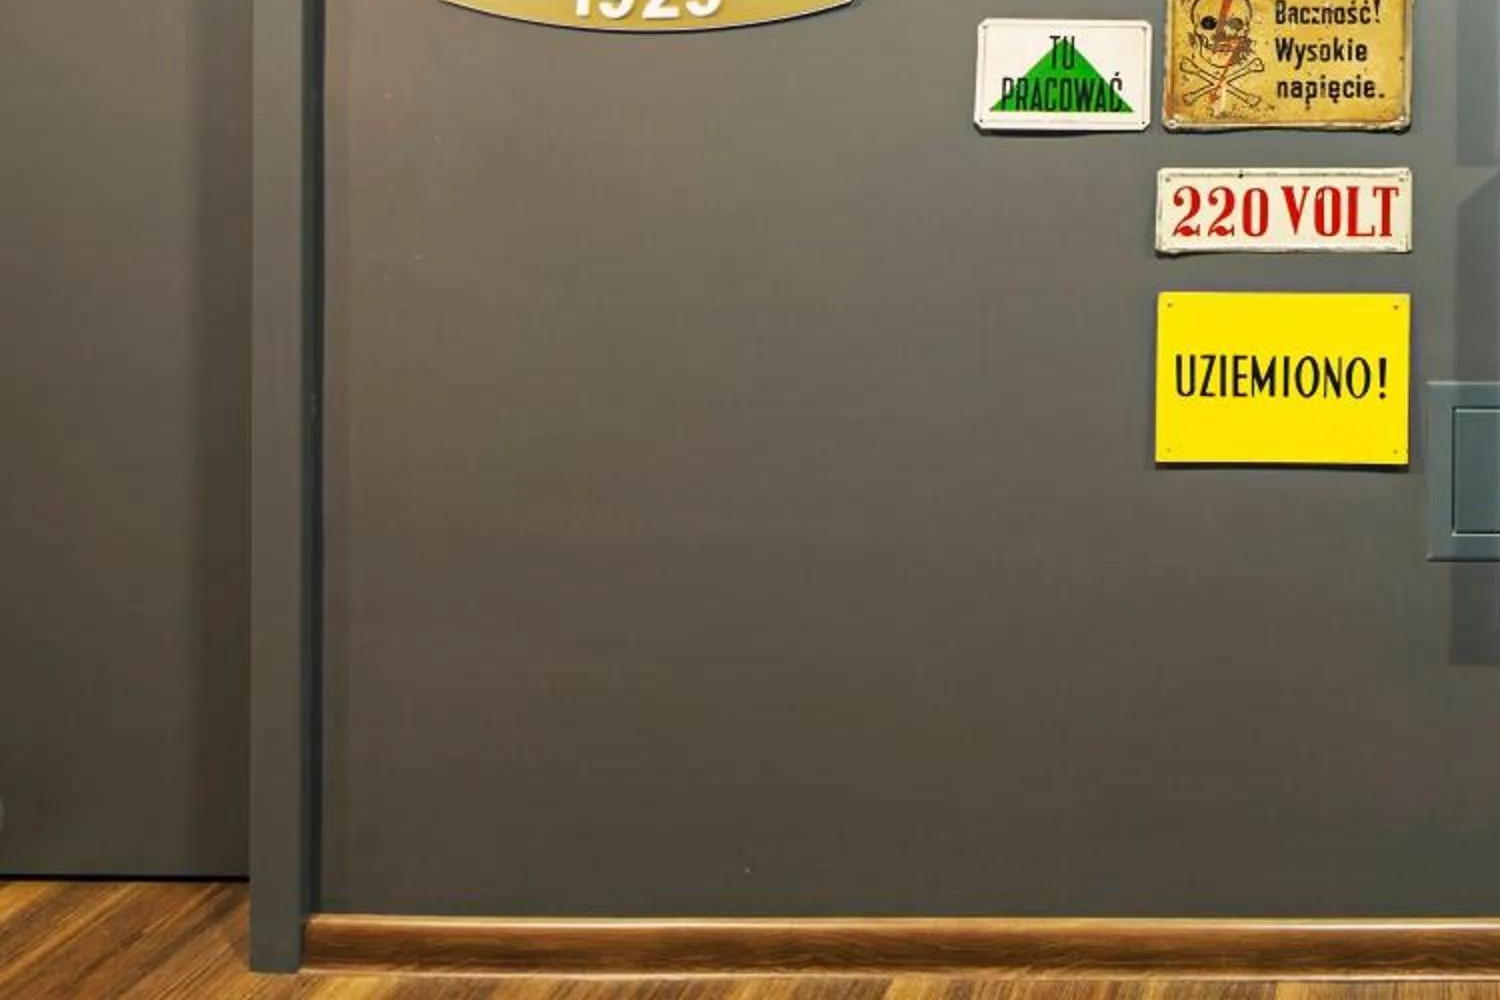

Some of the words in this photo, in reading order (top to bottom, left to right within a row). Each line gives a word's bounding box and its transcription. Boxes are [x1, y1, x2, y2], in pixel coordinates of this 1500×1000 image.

[1274, 0, 1381, 25] Baczność!
[1049, 35, 1076, 70] TU
[1275, 37, 1368, 70] Wysokie
[1001, 72, 1123, 112] PRACOWAĆ
[1277, 75, 1385, 109] napięcie.
[1172, 186, 1269, 237] 220
[1280, 185, 1399, 237] VOLT
[1175, 354, 1387, 400] UZIEMIONO!
